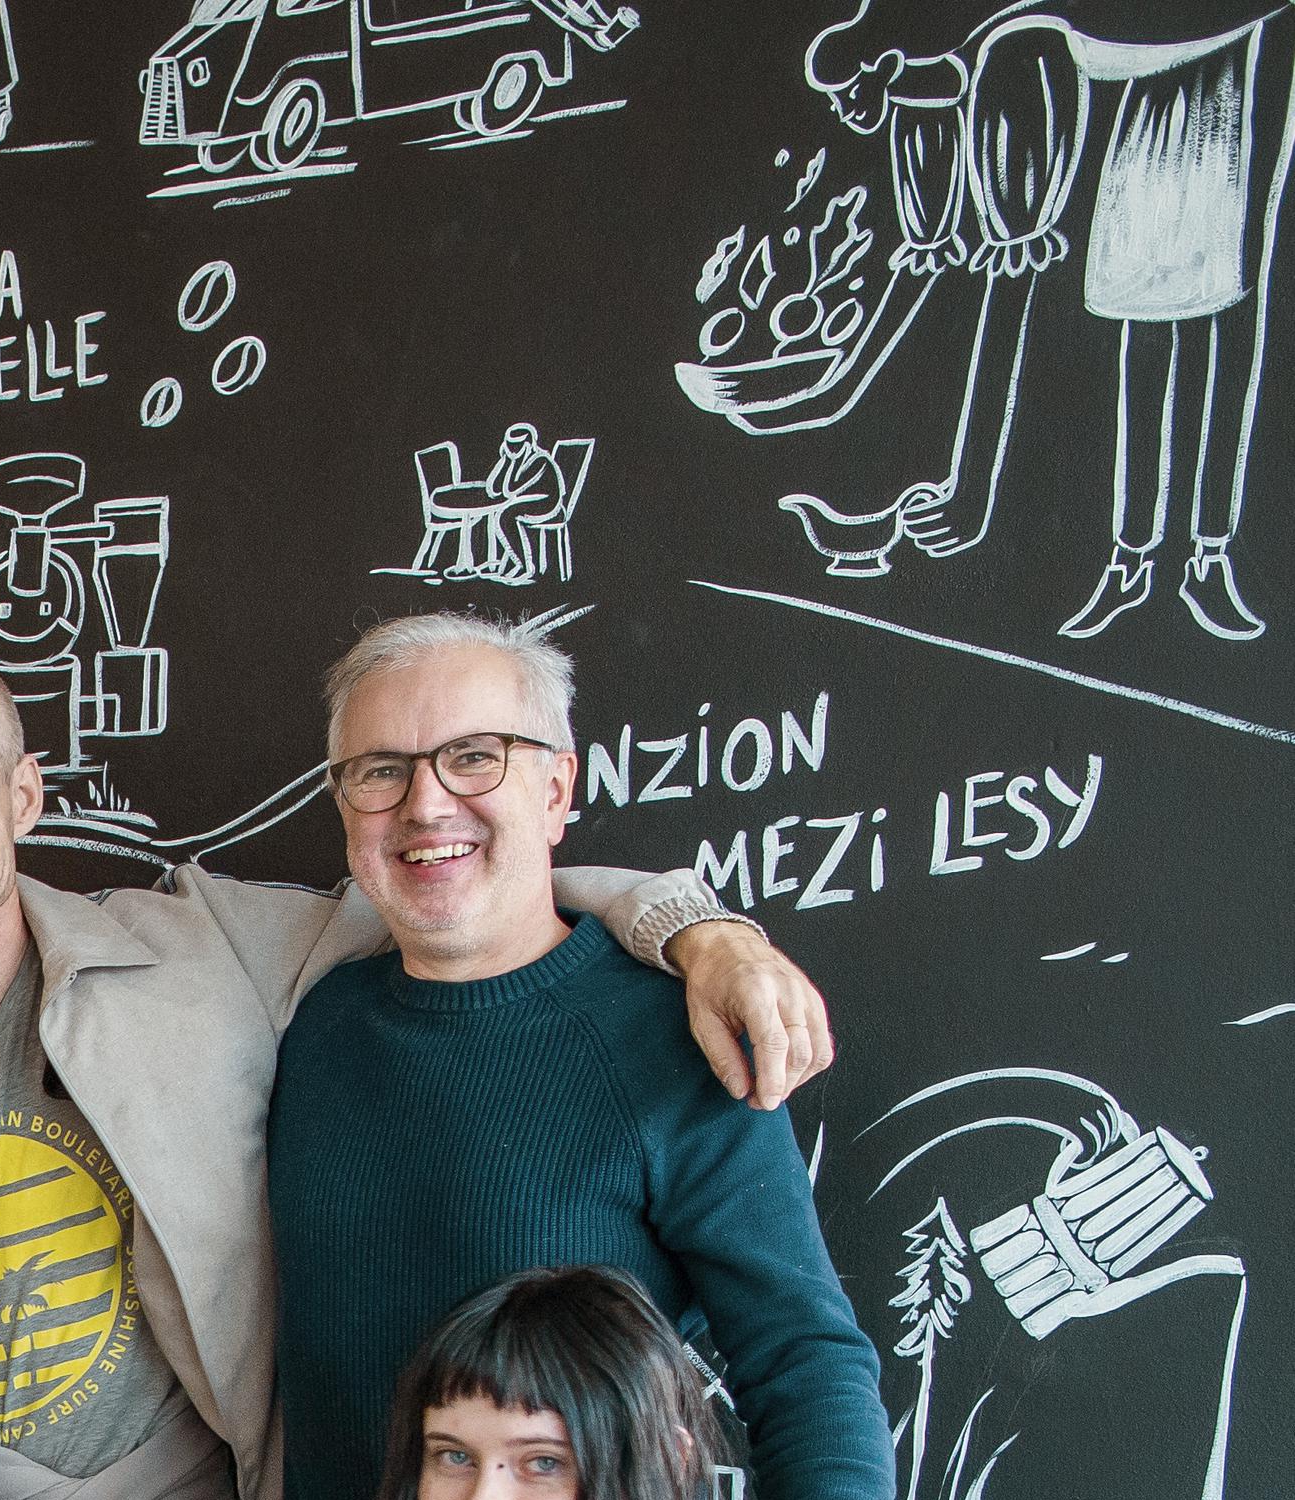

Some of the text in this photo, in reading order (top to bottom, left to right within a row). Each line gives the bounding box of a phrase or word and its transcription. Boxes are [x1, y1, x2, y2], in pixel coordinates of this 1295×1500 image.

[563, 690, 830, 824] NZION
[928, 753, 1103, 876] LESY
[46, 1378, 101, 1427] SURF
